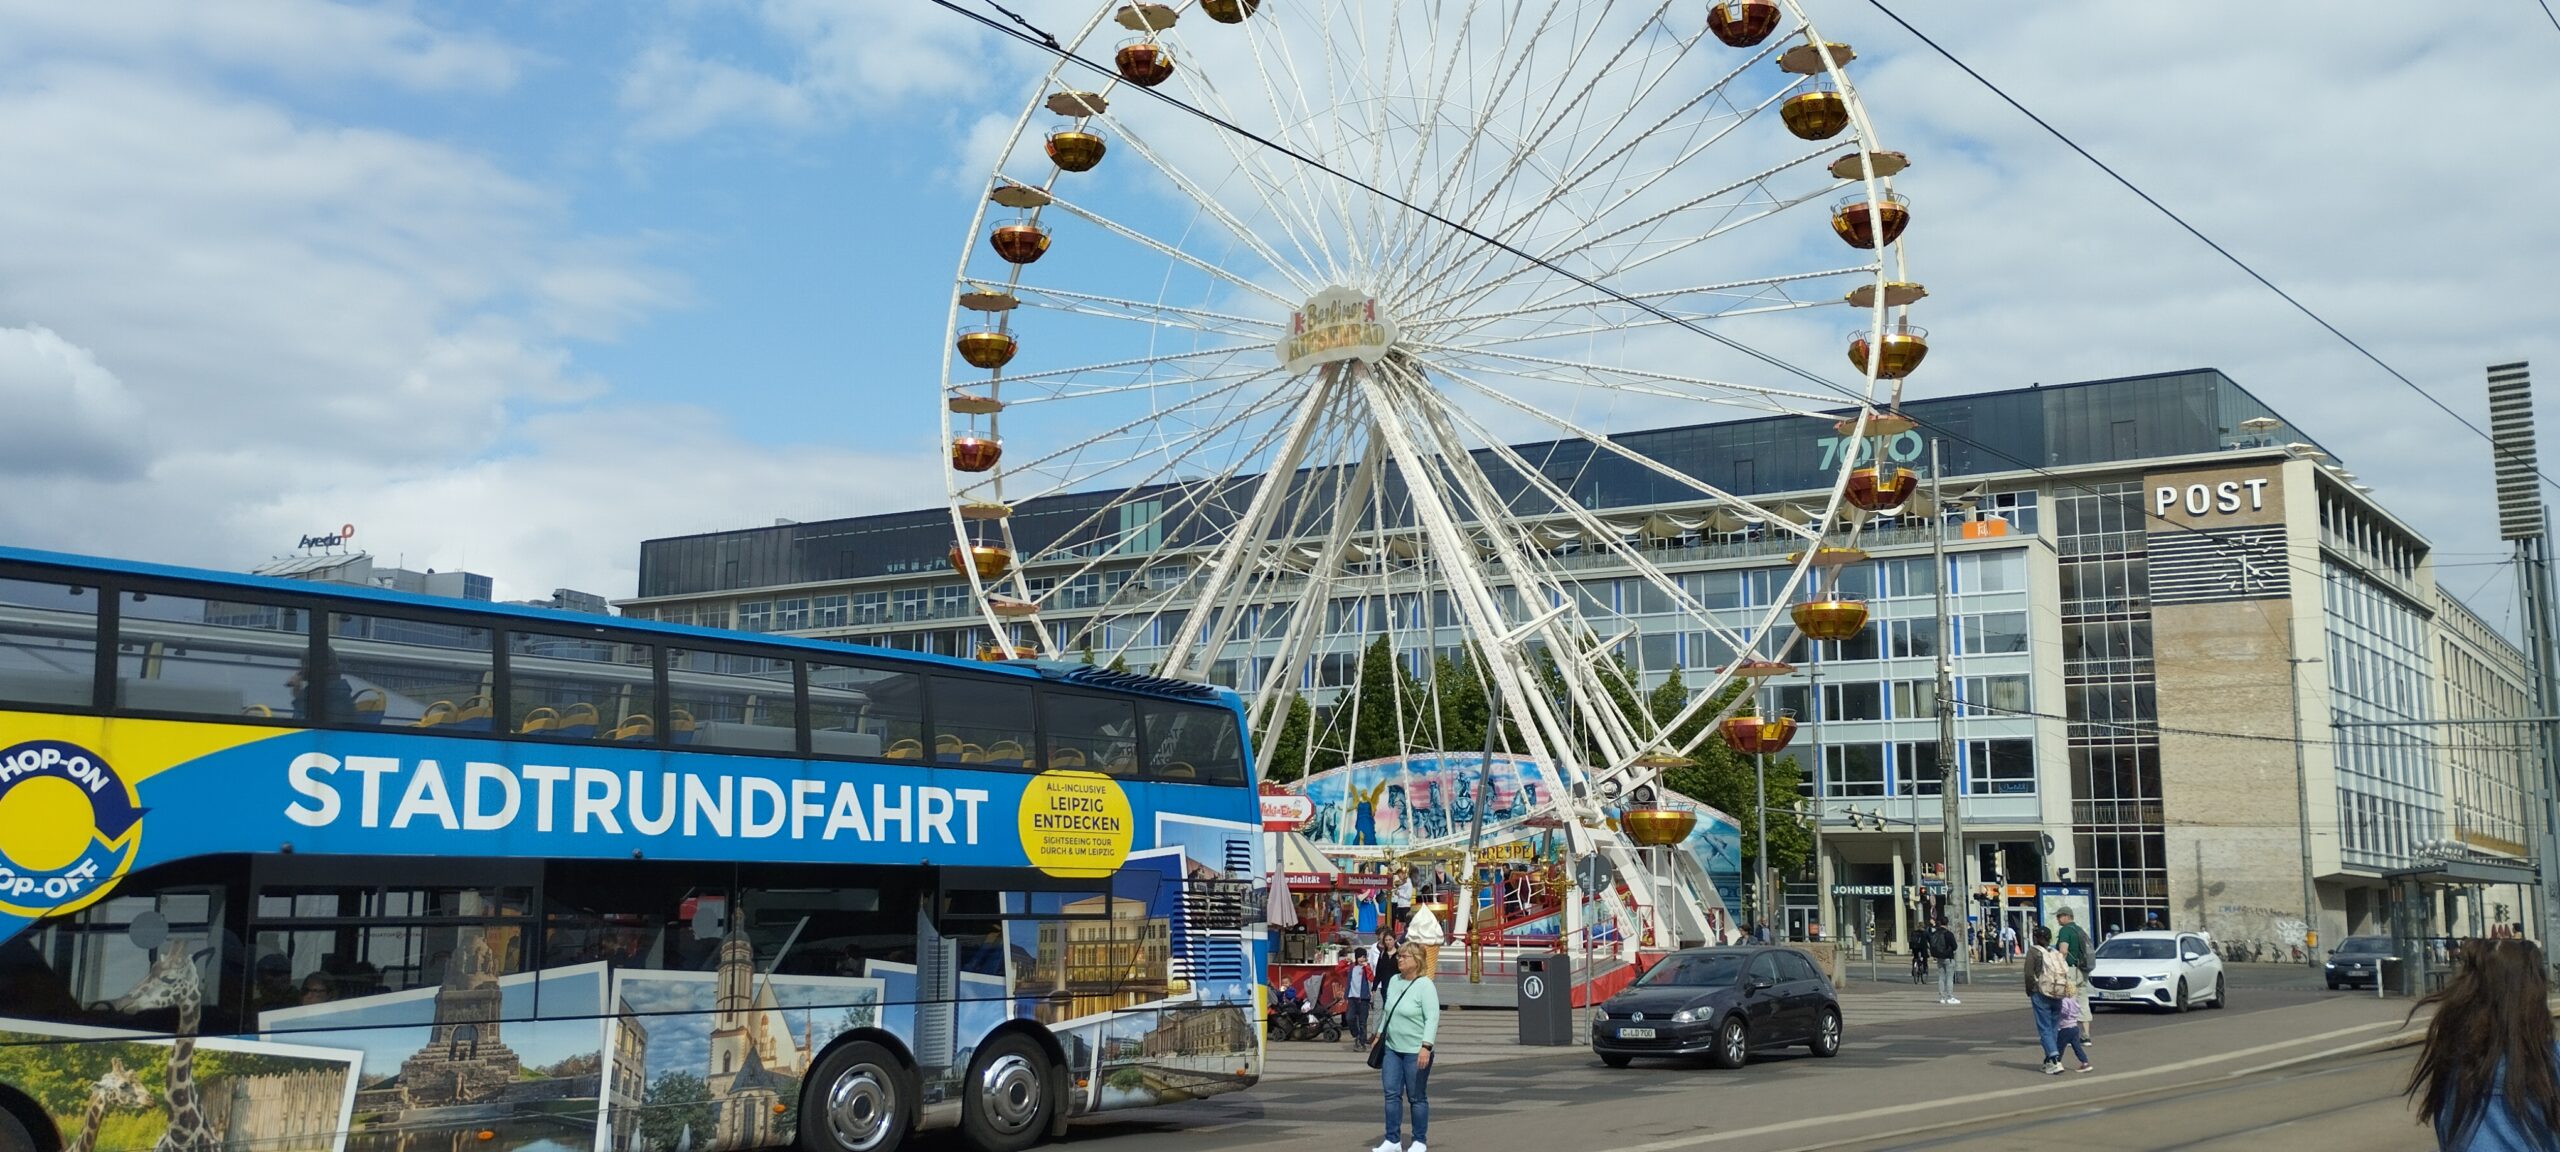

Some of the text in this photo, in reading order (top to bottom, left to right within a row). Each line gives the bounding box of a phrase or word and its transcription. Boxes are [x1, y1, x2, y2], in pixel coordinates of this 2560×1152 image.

[2156, 478, 2268, 516] POST
[0, 748, 110, 793] HOP-ON
[1046, 782, 1107, 794] ALL-INCLUSIVE
[284, 751, 989, 845] STADTRUNDFAHRT
[1050, 796, 1104, 812] LEIPZIG
[1034, 814, 1120, 831] ENTDECKEN
[1043, 836, 1112, 846] SIGHTSEEING TOUR
[1040, 847, 1067, 855] DURCH
[1088, 848, 1115, 856] LEIPZIG
[0, 858, 99, 899] OP-OFF
[1833, 885, 1863, 895] JOHN
[1864, 885, 1893, 895] REED
